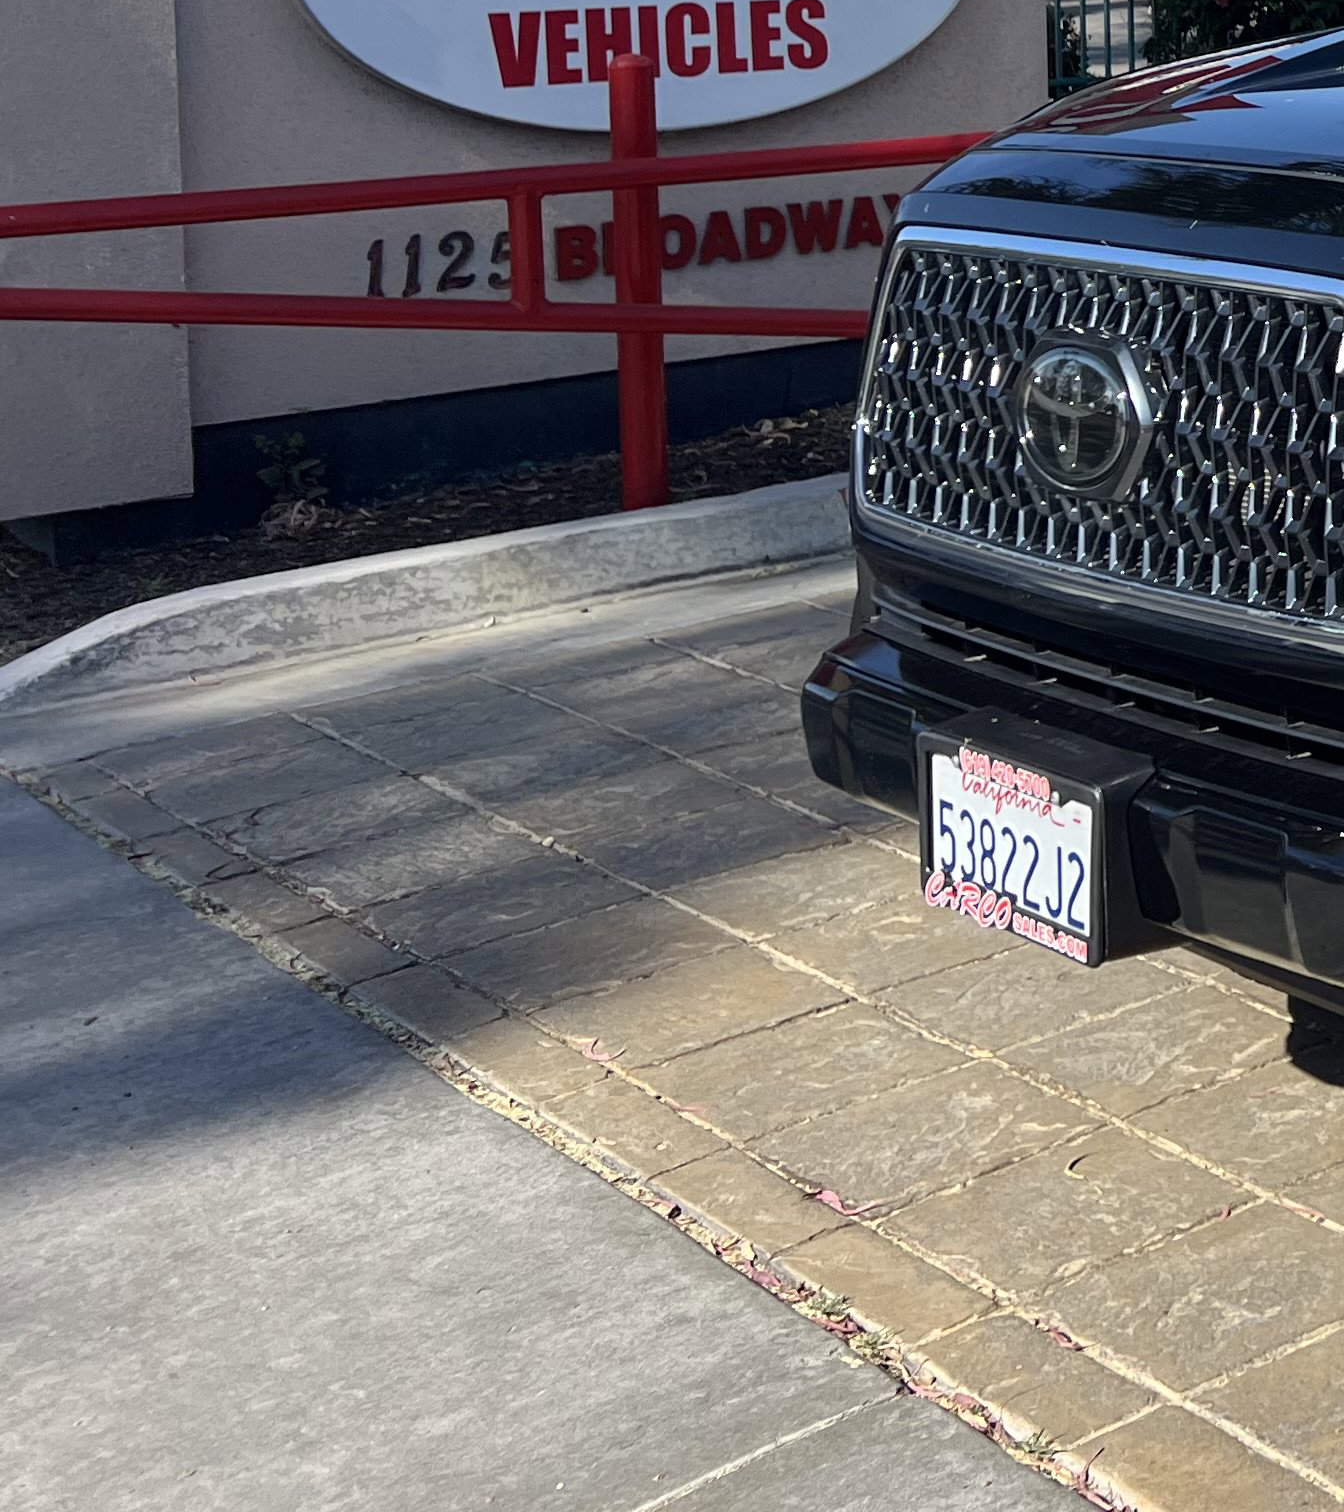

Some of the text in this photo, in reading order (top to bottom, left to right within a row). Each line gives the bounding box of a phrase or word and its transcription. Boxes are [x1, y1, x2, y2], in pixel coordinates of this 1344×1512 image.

[554, 194, 900, 281] BOADWA
[959, 746, 991, 780] (619)
[962, 771, 1065, 826] California
[939, 799, 1085, 930] 53822J2
[1013, 912, 1088, 963] SALES.COM
